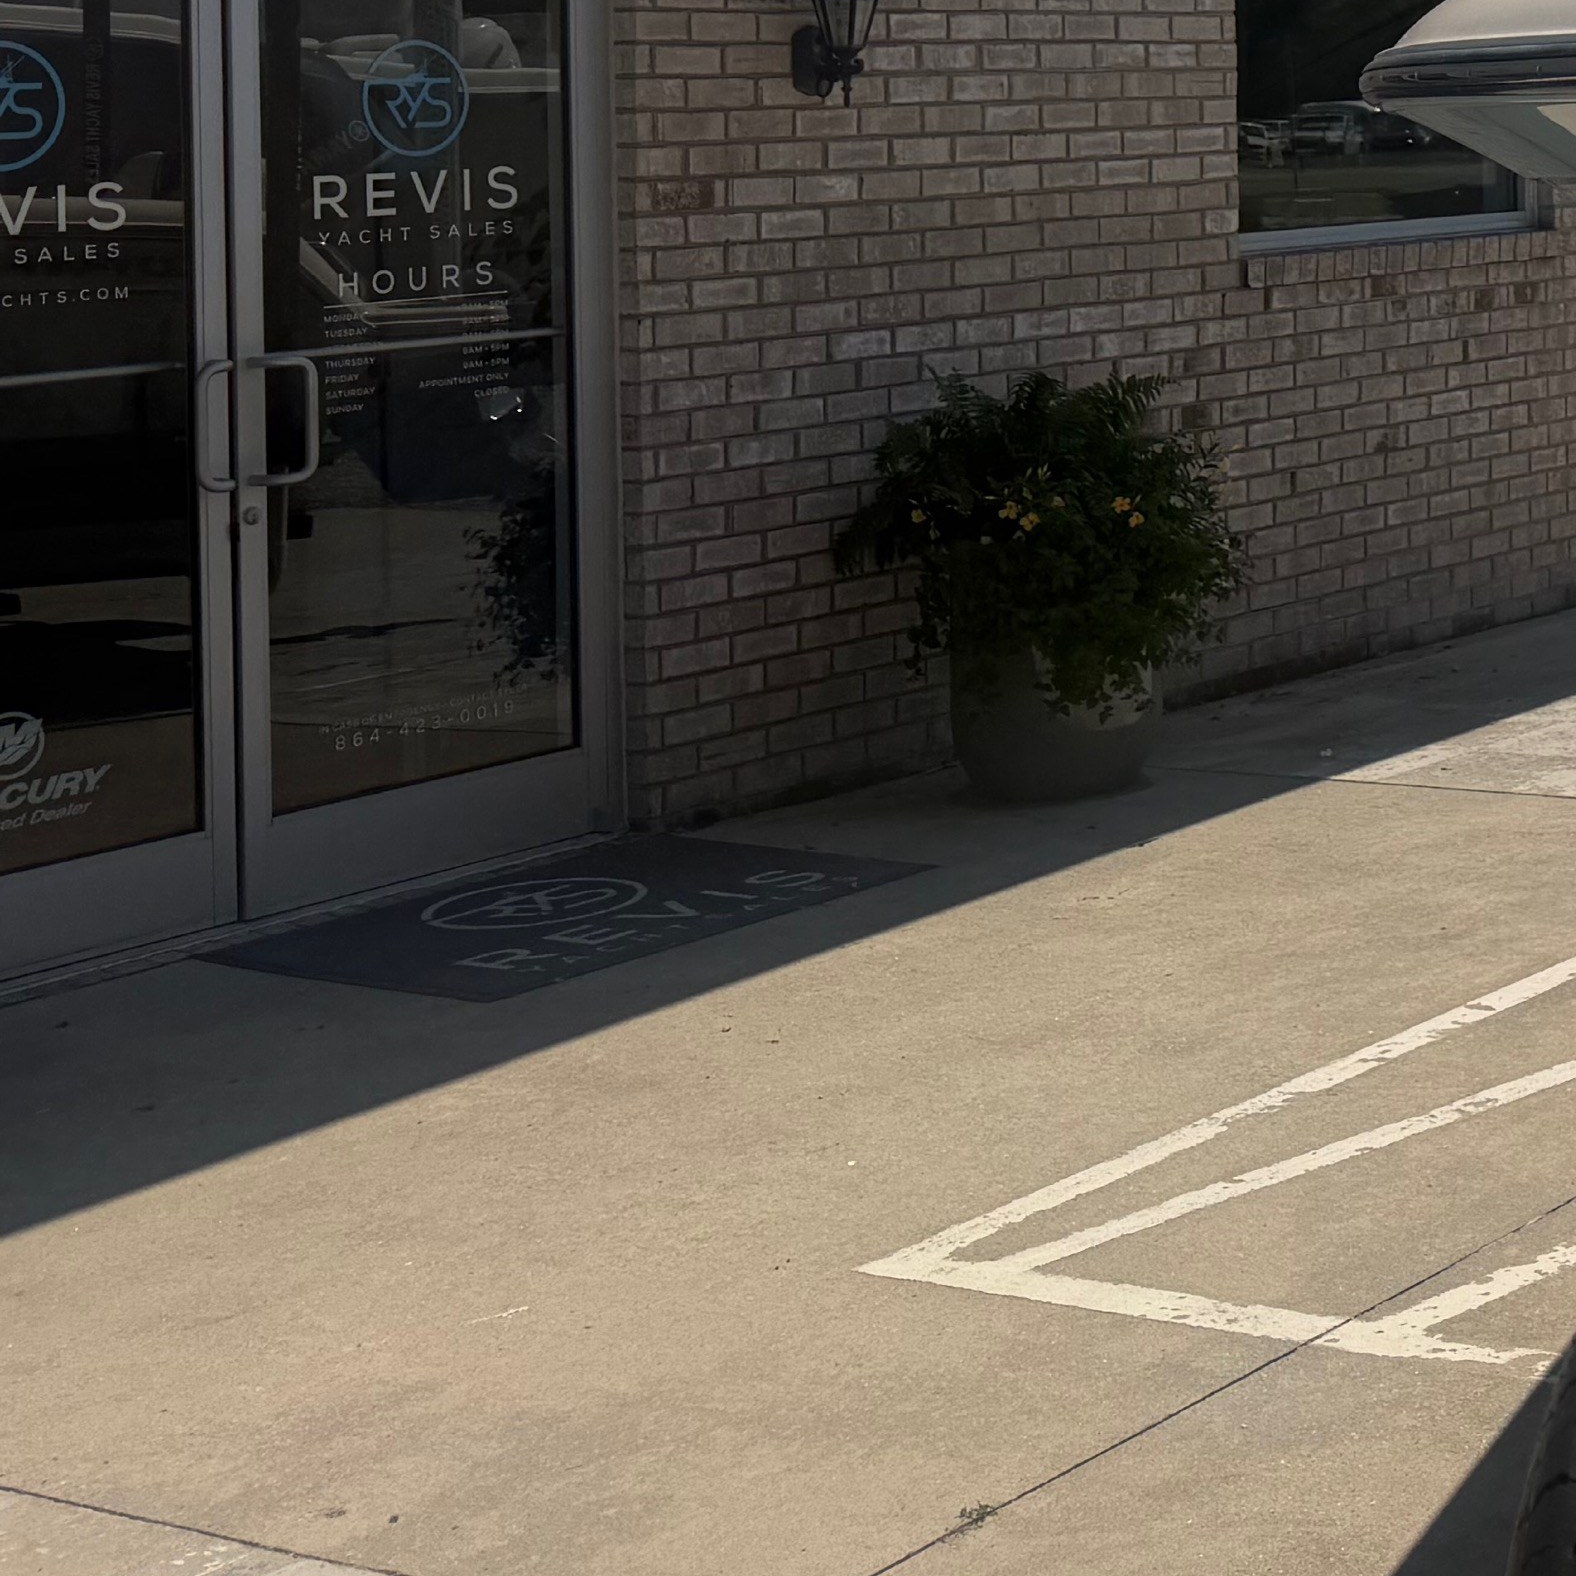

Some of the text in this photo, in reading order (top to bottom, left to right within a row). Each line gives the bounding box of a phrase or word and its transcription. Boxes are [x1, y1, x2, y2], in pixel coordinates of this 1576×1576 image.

[312, 165, 519, 220] REVIS
[318, 220, 514, 246] YACHT SALES
[14, 242, 121, 265] SALES
[338, 260, 494, 297] HOURS
[324, 327, 369, 338] TUESDAY
[324, 356, 376, 369] THURSDAY
[324, 373, 360, 385] FRIDAY
[418, 372, 510, 389] APPOINTMENT ONLY
[325, 386, 376, 400] SATURDAY
[474, 385, 510, 398] CLOSED
[325, 403, 364, 415] SUNDAY
[334, 700, 514, 751] 864-423-0019
[30, 801, 93, 826] Dealer
[451, 869, 826, 971] REVIS
